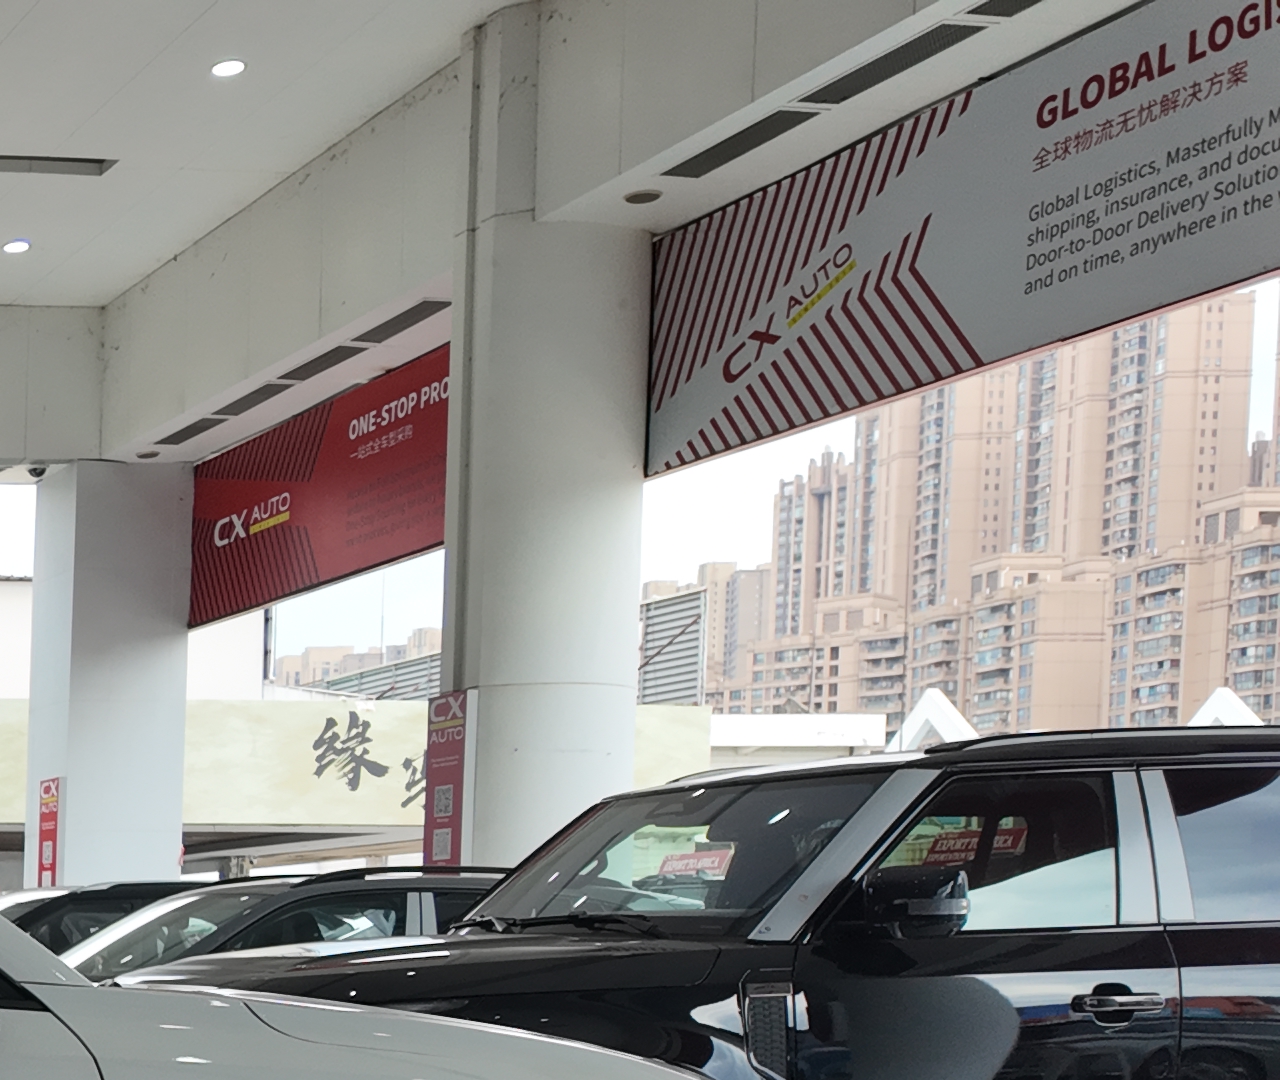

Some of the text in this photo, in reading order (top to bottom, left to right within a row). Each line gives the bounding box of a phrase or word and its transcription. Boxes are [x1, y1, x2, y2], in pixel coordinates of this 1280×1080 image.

[1032, 60, 1249, 172] 全球物流无忧解决方案
[1036, 43, 1176, 129] GLOBAL
[1026, 209, 1100, 247] shipping,
[1104, 172, 1193, 217] insurance,
[1197, 152, 1232, 181] and
[1029, 186, 1080, 222] Global
[1084, 159, 1161, 201] Logistics,
[1165, 115, 1264, 168] Masterfully
[1024, 193, 1273, 295] and on time, anywhere in the
[1026, 219, 1133, 271] Door-to-Door
[1137, 190, 1210, 229] Delivery
[722, 311, 782, 384] CX
[786, 243, 853, 319] AUTO
[348, 392, 416, 440] ONE-STOP
[214, 509, 247, 548] CX
[250, 492, 290, 524] AUTO
[430, 694, 464, 723] CX
[430, 727, 464, 745] AUTO
[40, 780, 58, 798] CX
